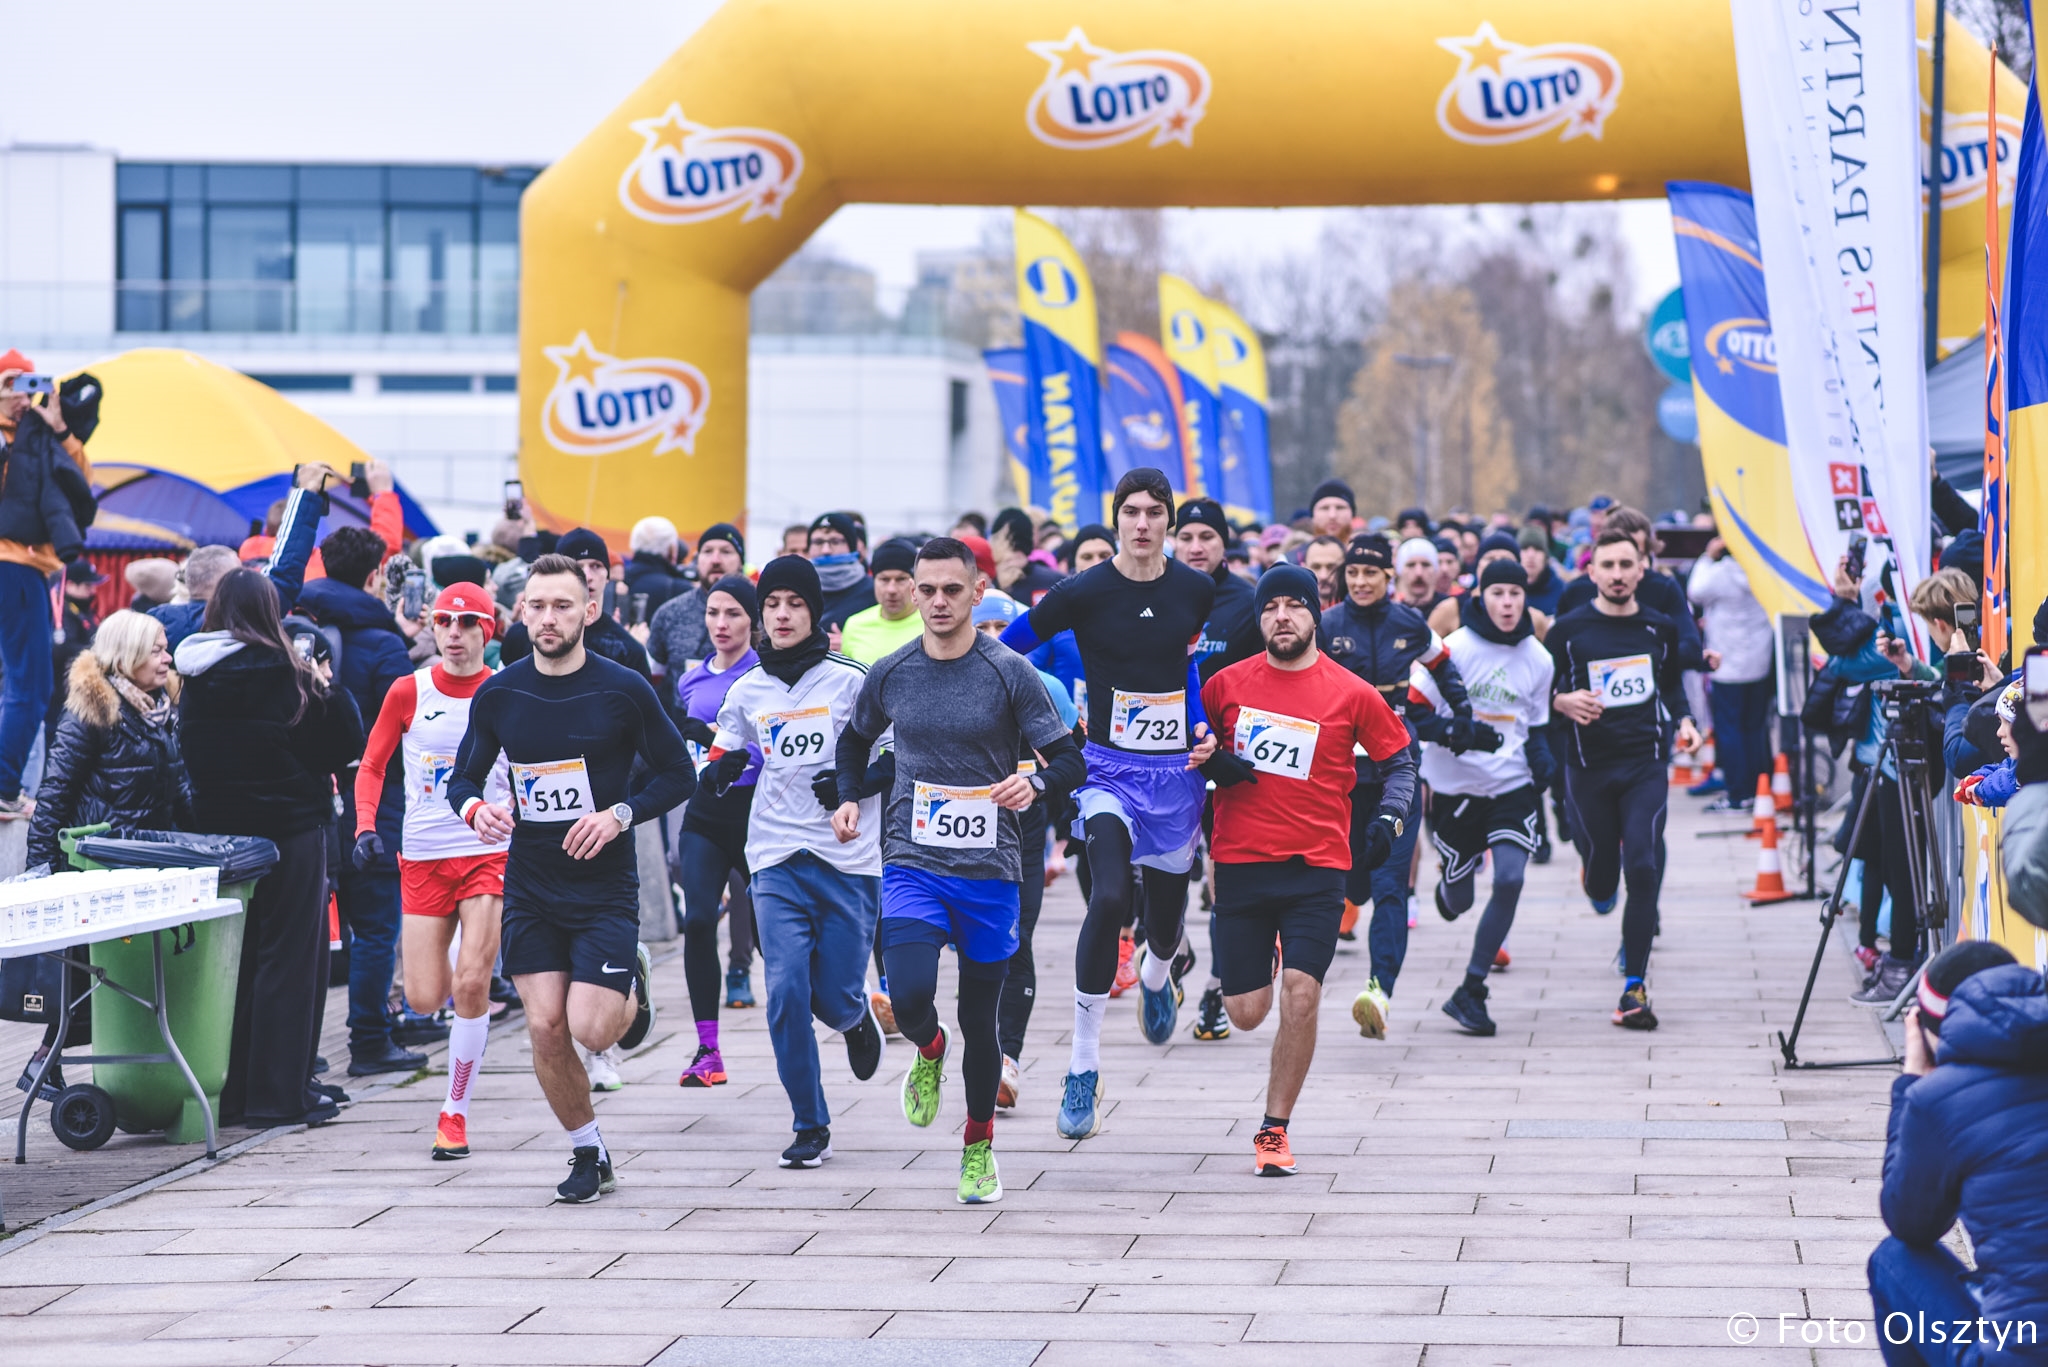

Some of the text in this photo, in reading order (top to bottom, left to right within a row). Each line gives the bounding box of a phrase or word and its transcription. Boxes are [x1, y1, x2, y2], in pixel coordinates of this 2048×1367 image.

[1069, 74, 1170, 125] LOTTO
[1480, 68, 1581, 119] LOTTO
[662, 153, 762, 198] LOTTO
[576, 382, 674, 429] LOTTO
[1611, 677, 1646, 698] 653
[1136, 719, 1179, 741] 732
[781, 732, 824, 757] 699
[1254, 740, 1300, 769] 671
[535, 788, 583, 812] 512
[936, 814, 986, 838] 503
